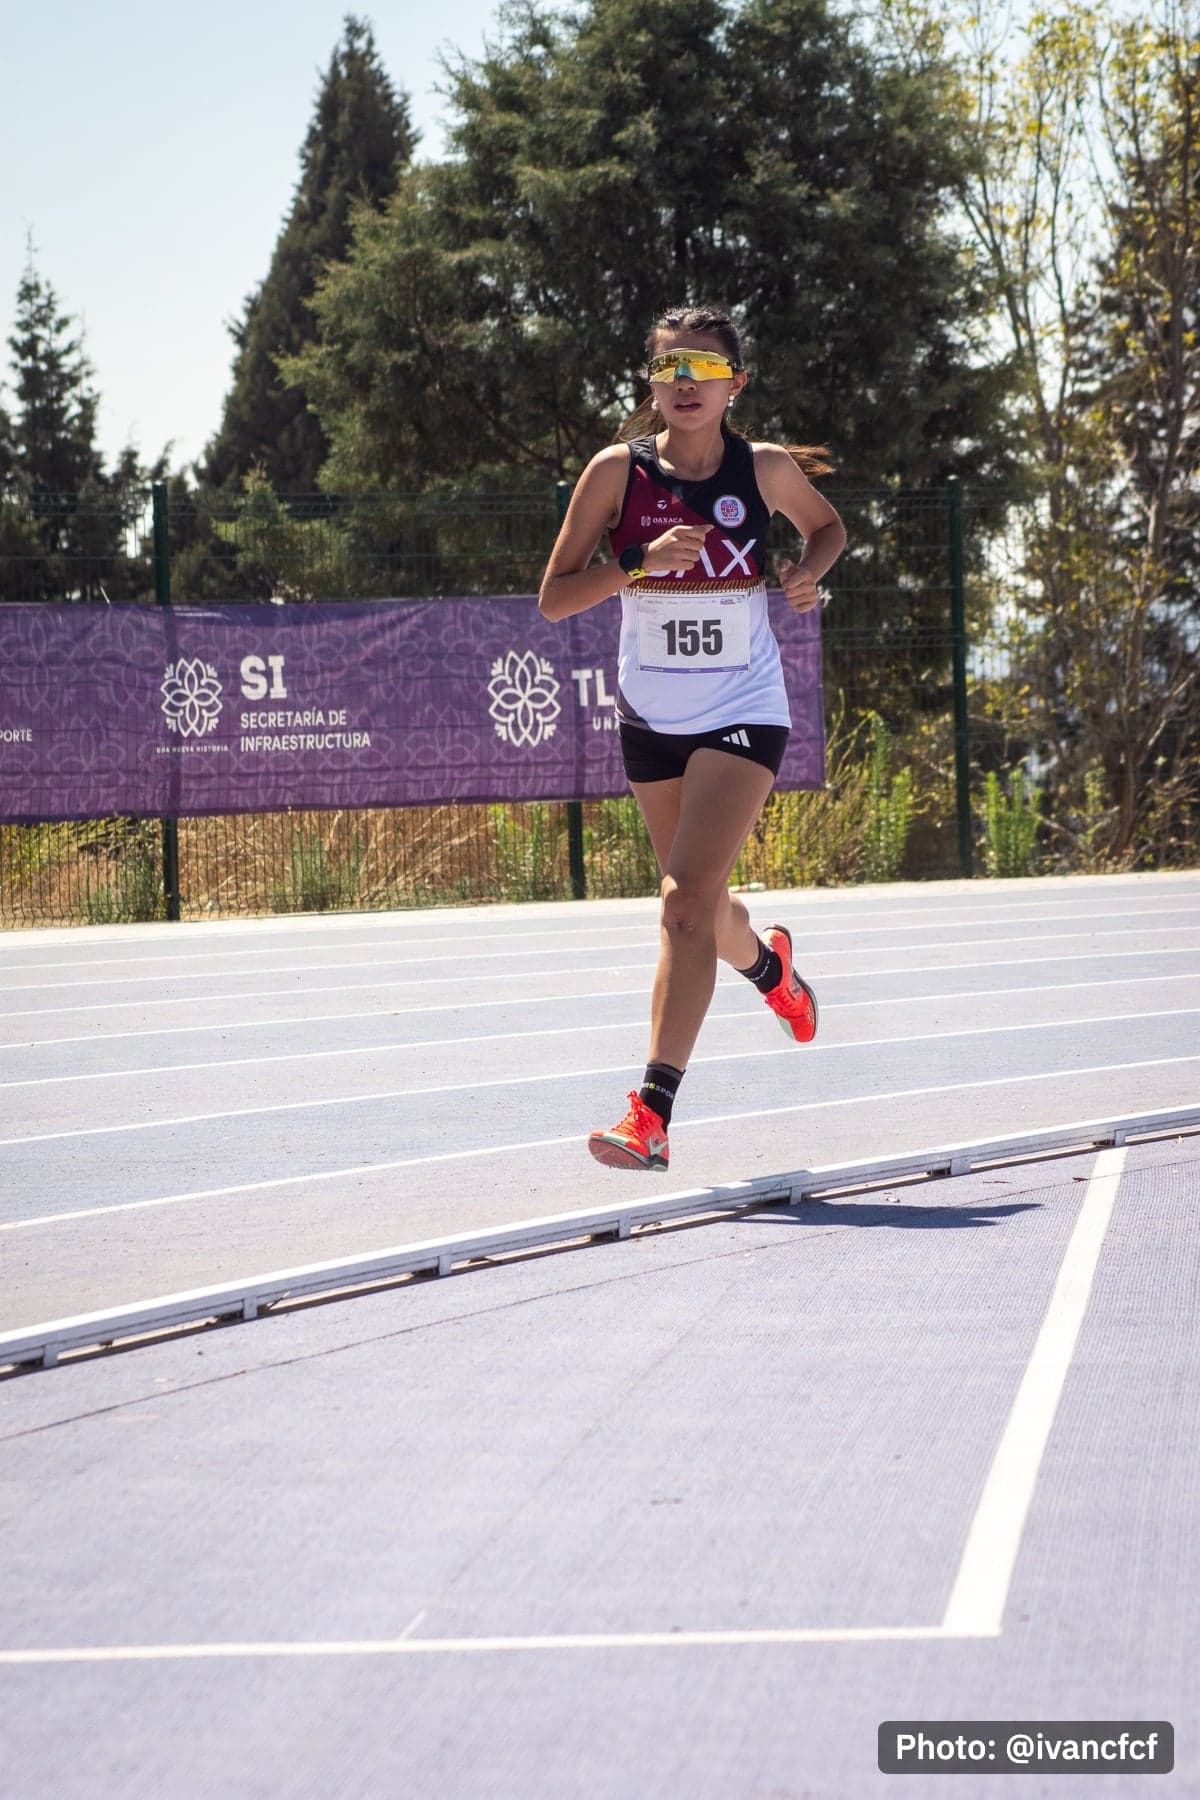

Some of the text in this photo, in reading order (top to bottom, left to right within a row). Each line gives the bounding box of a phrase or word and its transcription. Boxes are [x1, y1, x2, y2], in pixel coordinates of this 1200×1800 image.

[661, 619, 723, 656] 155
[240, 655, 288, 700] SI
[240, 706, 347, 728] SECRETARÍA DE
[240, 732, 371, 752] INFRAESTRUCTURA
